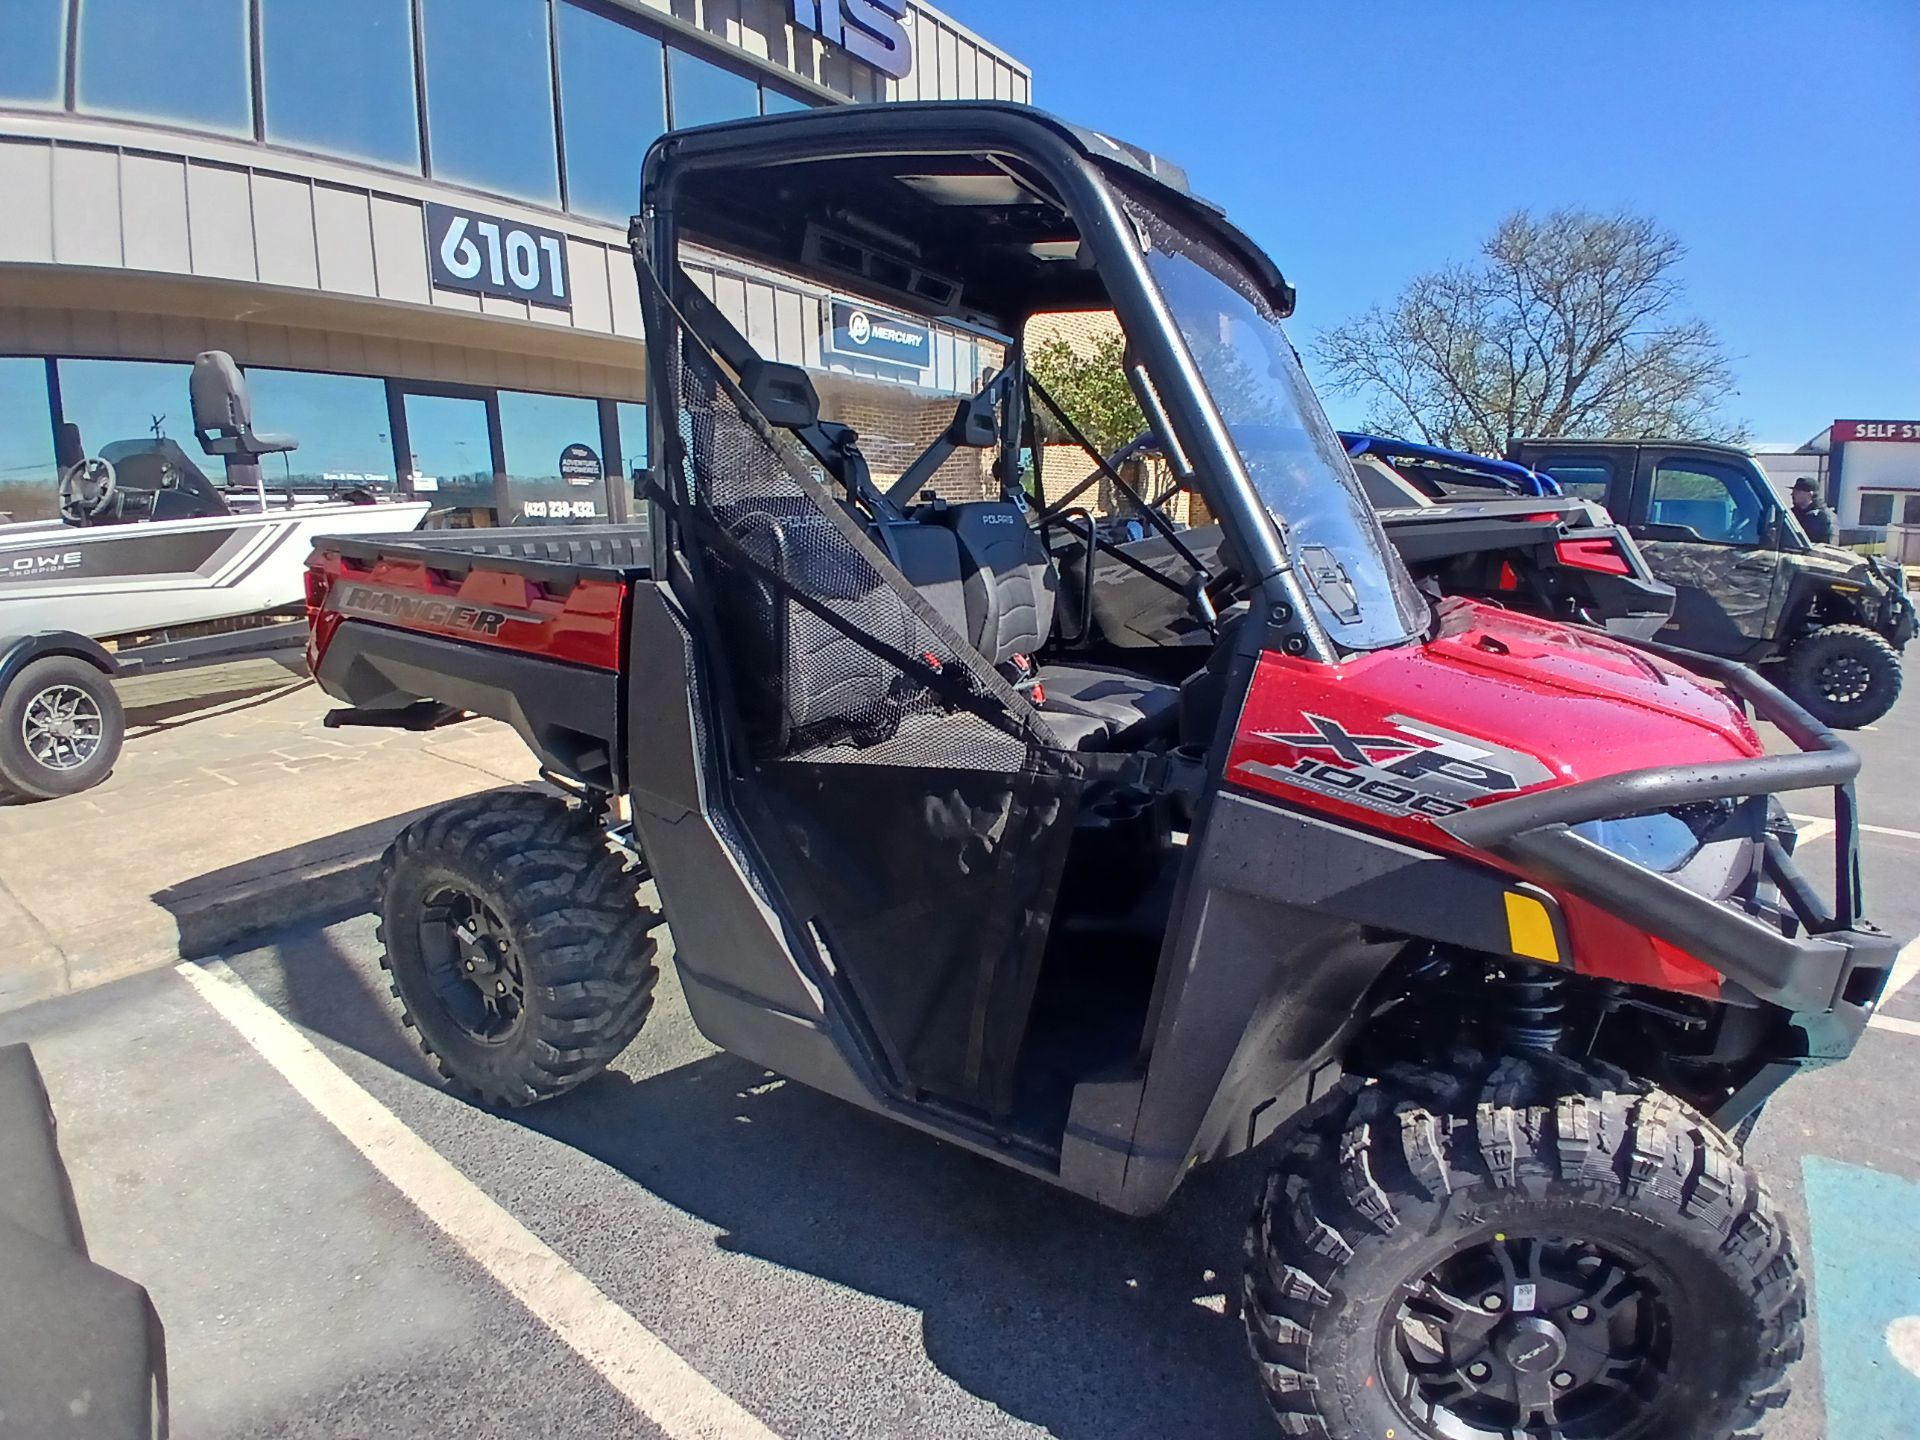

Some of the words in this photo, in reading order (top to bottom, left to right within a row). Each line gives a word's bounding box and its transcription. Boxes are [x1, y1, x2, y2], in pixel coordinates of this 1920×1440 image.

[440, 215, 565, 298] 6101
[871, 325, 923, 347] MERCURY
[1855, 423, 1897, 438] SELF
[982, 514, 1014, 525] POLARIS
[346, 587, 505, 636] RANGER
[1250, 710, 1521, 794] XP
[1284, 775, 1323, 792] DUAL
[1292, 756, 1470, 819] 1000
